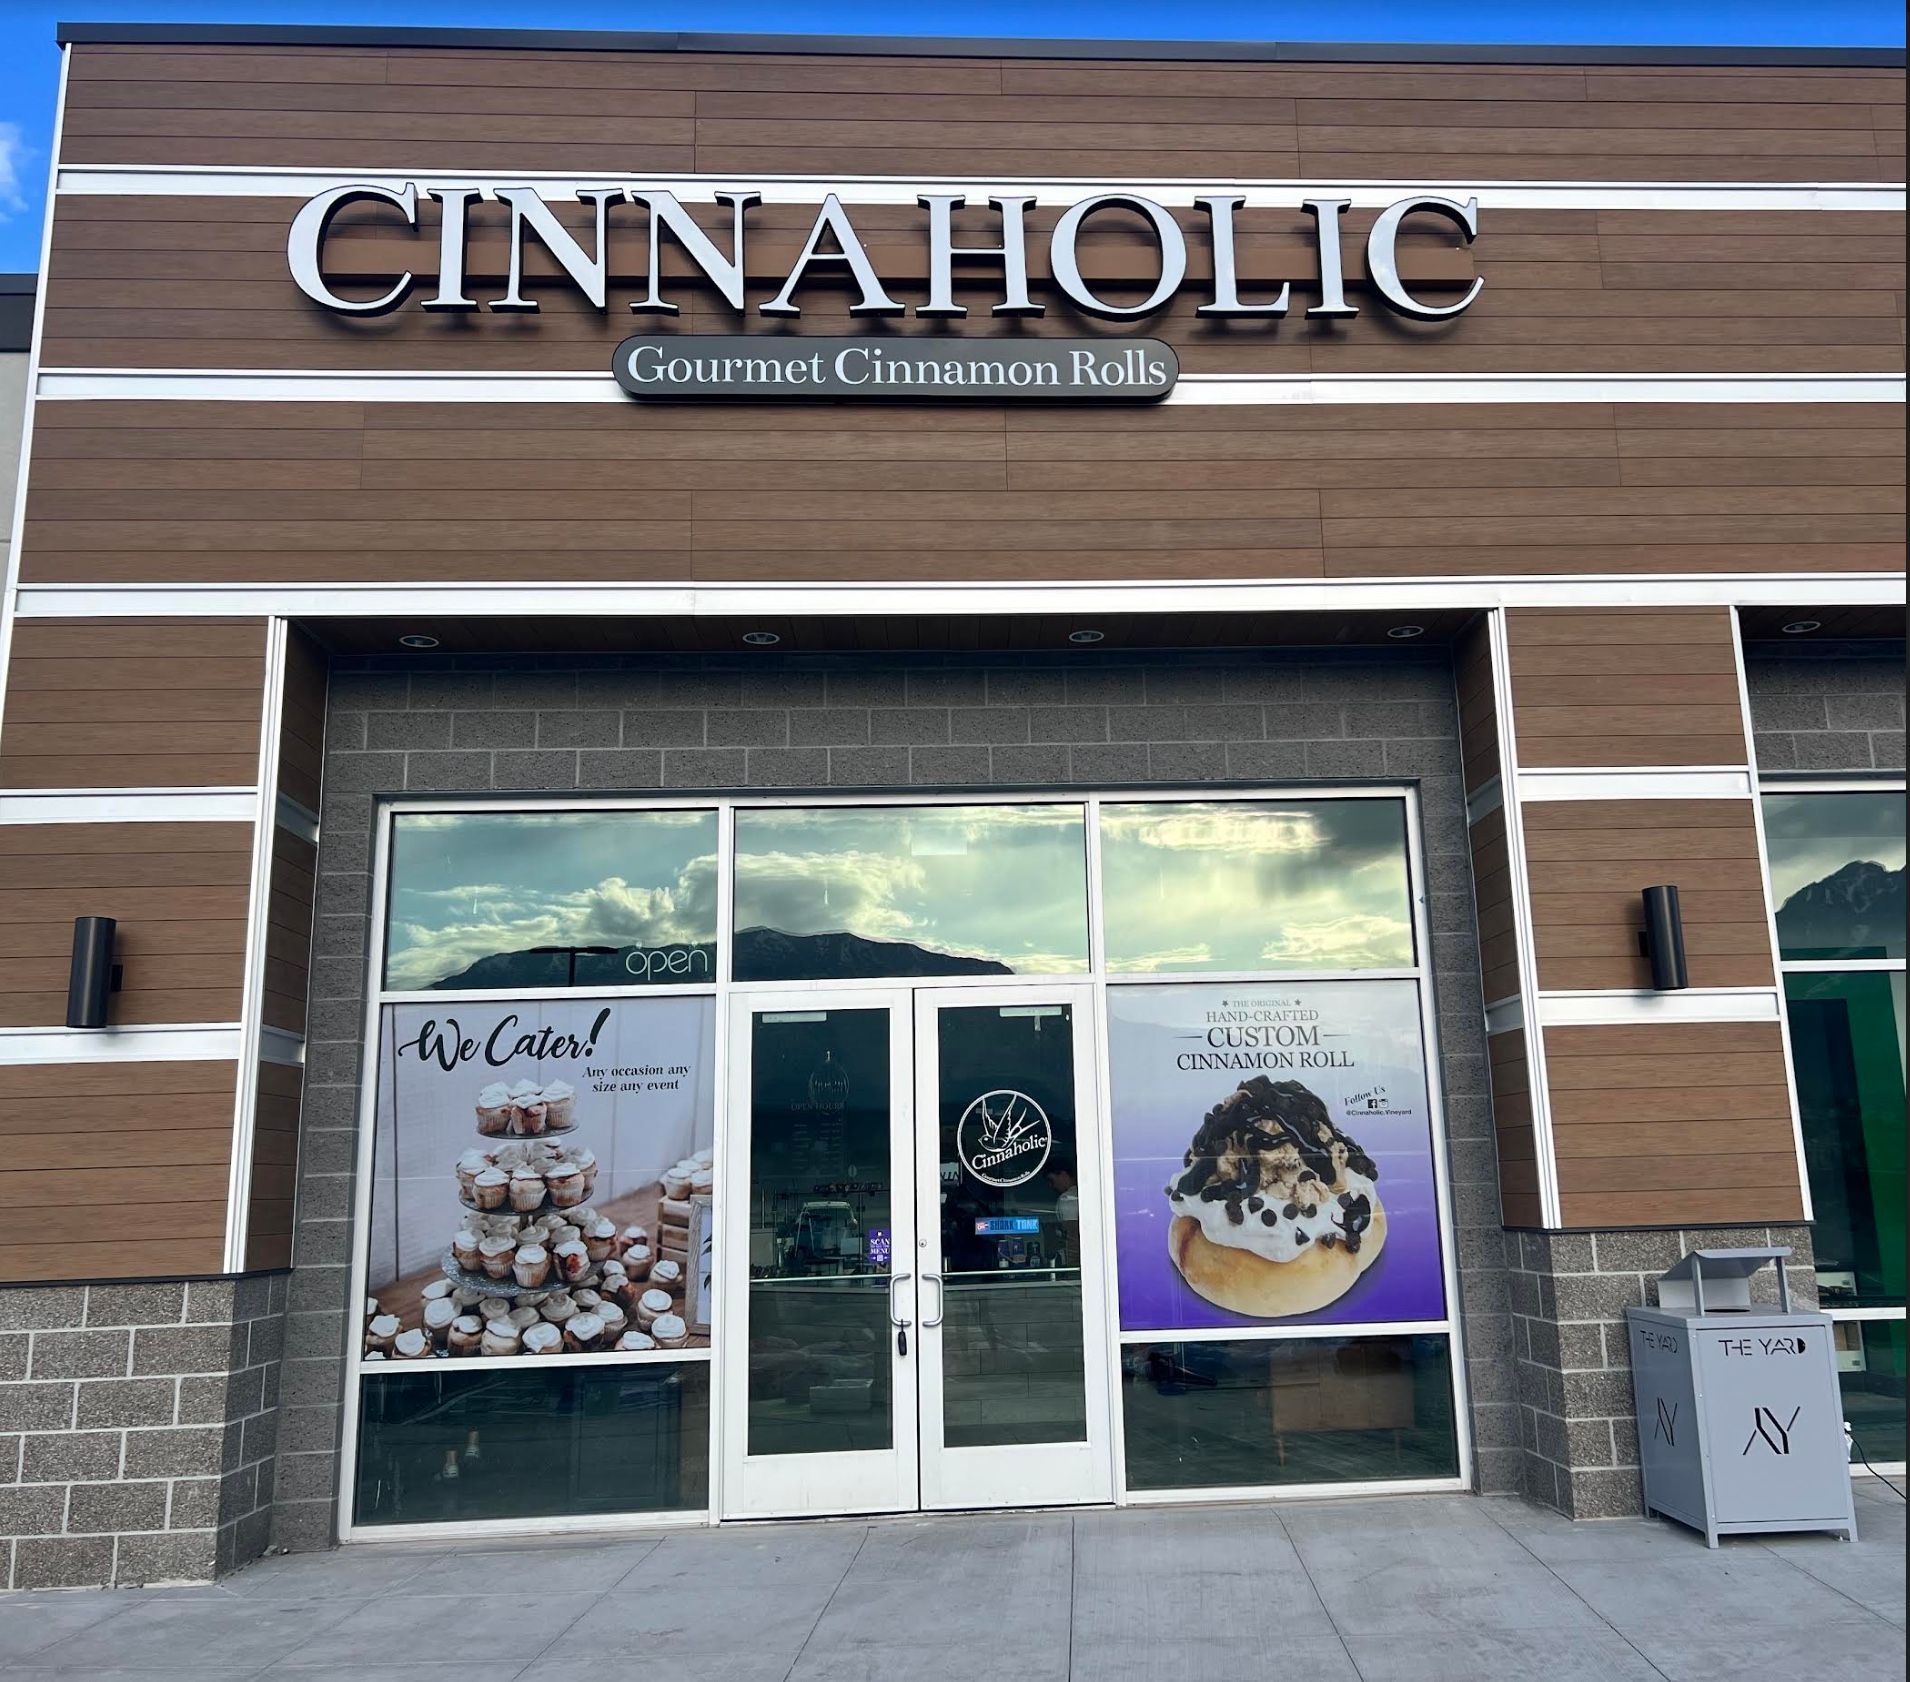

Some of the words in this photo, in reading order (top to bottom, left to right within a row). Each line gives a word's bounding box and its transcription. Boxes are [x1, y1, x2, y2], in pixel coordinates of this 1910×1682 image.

[286, 182, 1486, 318] CINNAHOLIC
[627, 346, 826, 384] Gourmet
[834, 347, 1061, 386] Cinnamon
[1069, 349, 1168, 386] Rolls
[625, 947, 708, 981] open
[1251, 999, 1291, 1007] ORIGINAL
[1206, 1009, 1319, 1022] HAND-CRAFTED
[398, 1019, 481, 1072] We
[484, 1007, 611, 1067] Cater!
[1207, 1025, 1320, 1048] CUSTOM
[1176, 1051, 1293, 1070] CINNAMON
[1299, 1051, 1355, 1068] ROLL
[582, 1066, 608, 1080] Any
[611, 1065, 663, 1077] occasion
[668, 1065, 691, 1077] any
[592, 1081, 617, 1092] size
[620, 1082, 643, 1094] any
[647, 1079, 680, 1091] event
[1344, 1090, 1371, 1106] Follow
[972, 1134, 1048, 1170] Cinnaholic
[870, 1238, 890, 1246] SCAN
[870, 1247, 890, 1255] MENU
[1718, 1339, 1752, 1356] THE
[1758, 1337, 1806, 1354] YARD
